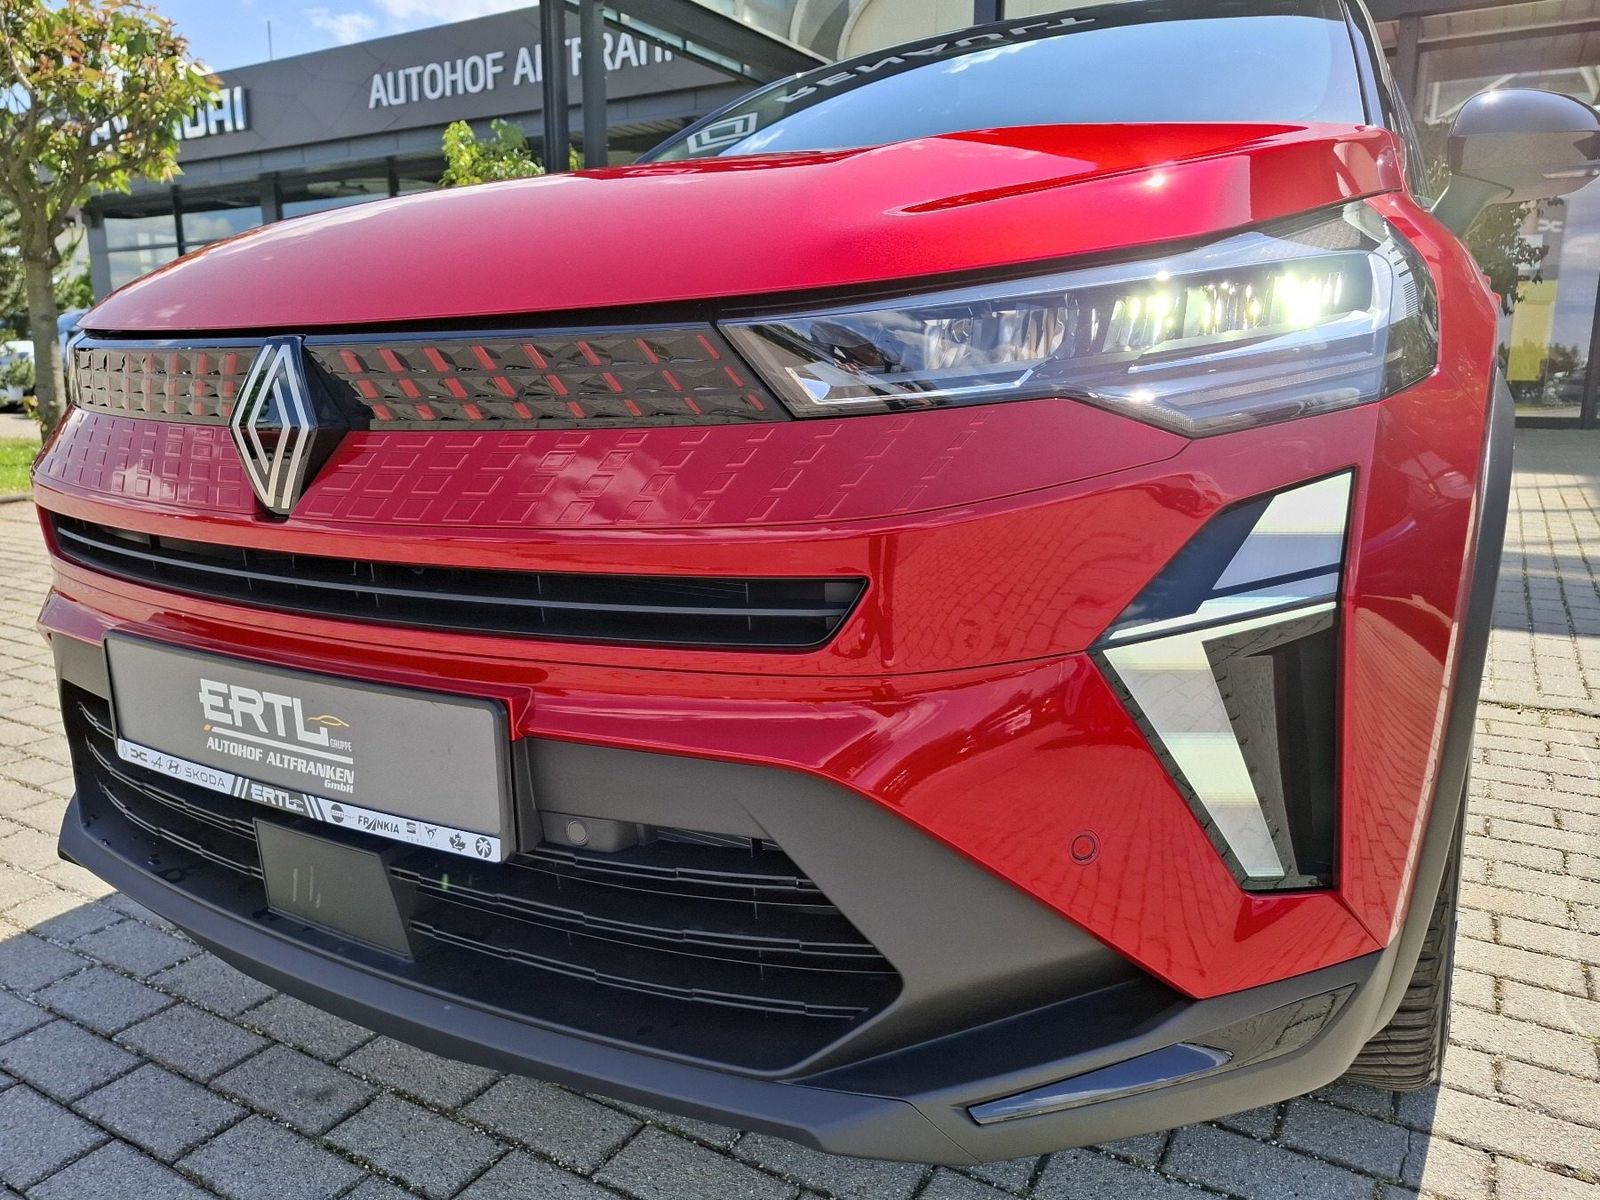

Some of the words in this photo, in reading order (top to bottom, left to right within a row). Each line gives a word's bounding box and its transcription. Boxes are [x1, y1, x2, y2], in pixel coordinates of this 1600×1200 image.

[368, 51, 505, 109] AUTOHOF
[199, 678, 329, 747] ERTL
[206, 736, 263, 761] AUTOHOF
[266, 751, 355, 785] ALTFRANKEN
[250, 783, 297, 811] ERTL
[357, 815, 400, 834] FRANKIA
[324, 779, 354, 794] GmbH
